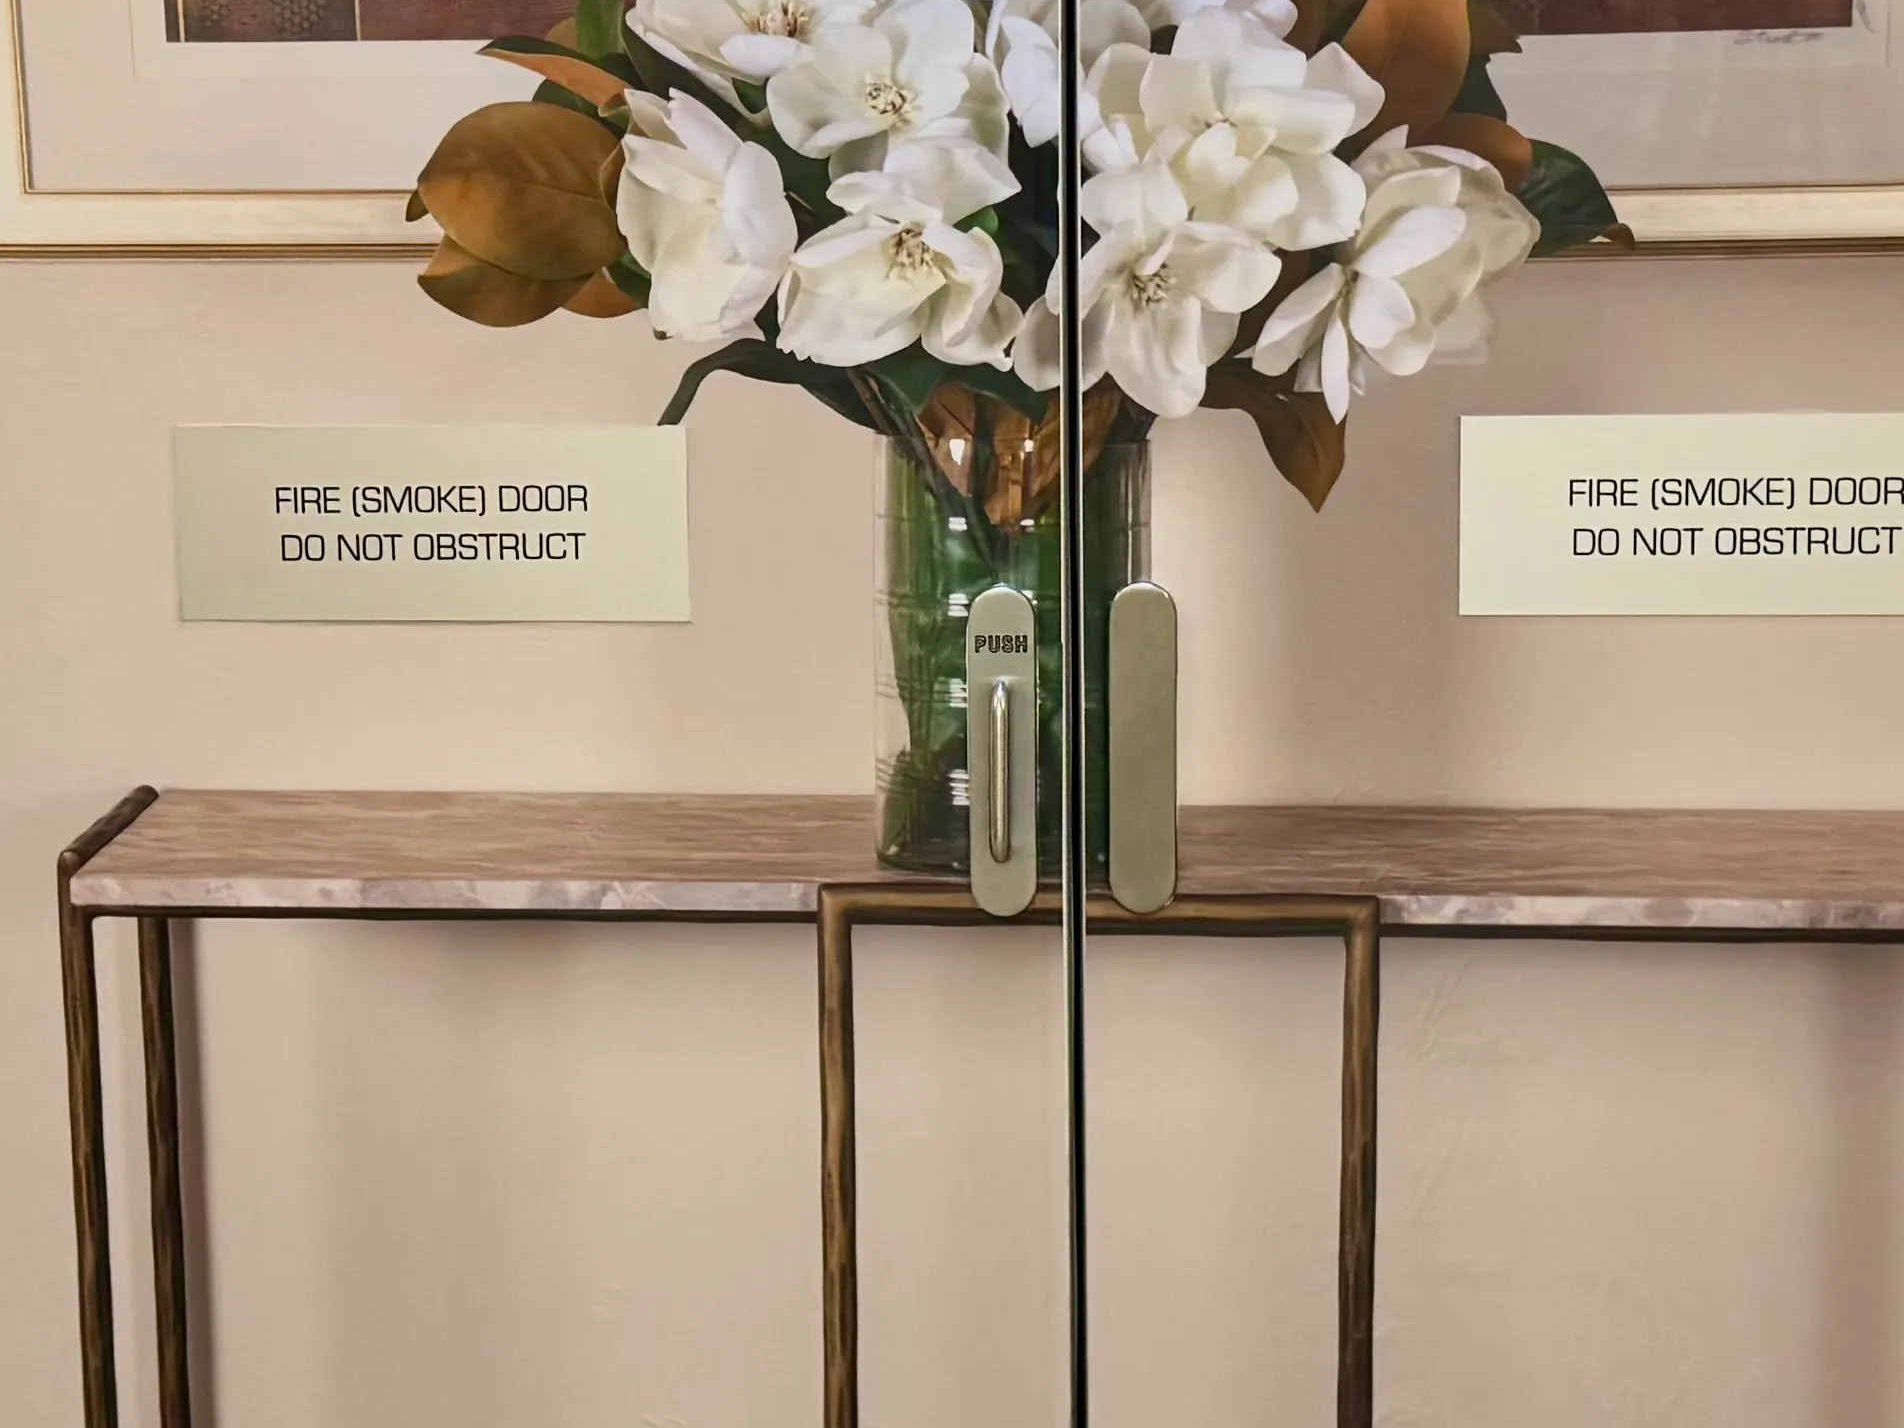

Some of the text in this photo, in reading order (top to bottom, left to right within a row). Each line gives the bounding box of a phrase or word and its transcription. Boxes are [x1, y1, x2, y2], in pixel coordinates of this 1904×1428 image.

[275, 484, 588, 518] FIRE (SMOKE) DOOR
[1568, 478, 1640, 508] FIRE
[1650, 477, 1796, 511] (SMOKE)
[280, 532, 587, 562] DO NOT OBSTRUCT
[1572, 526, 1903, 557] DO NOT OBSTRUCT
[974, 634, 1028, 654] PUSH
